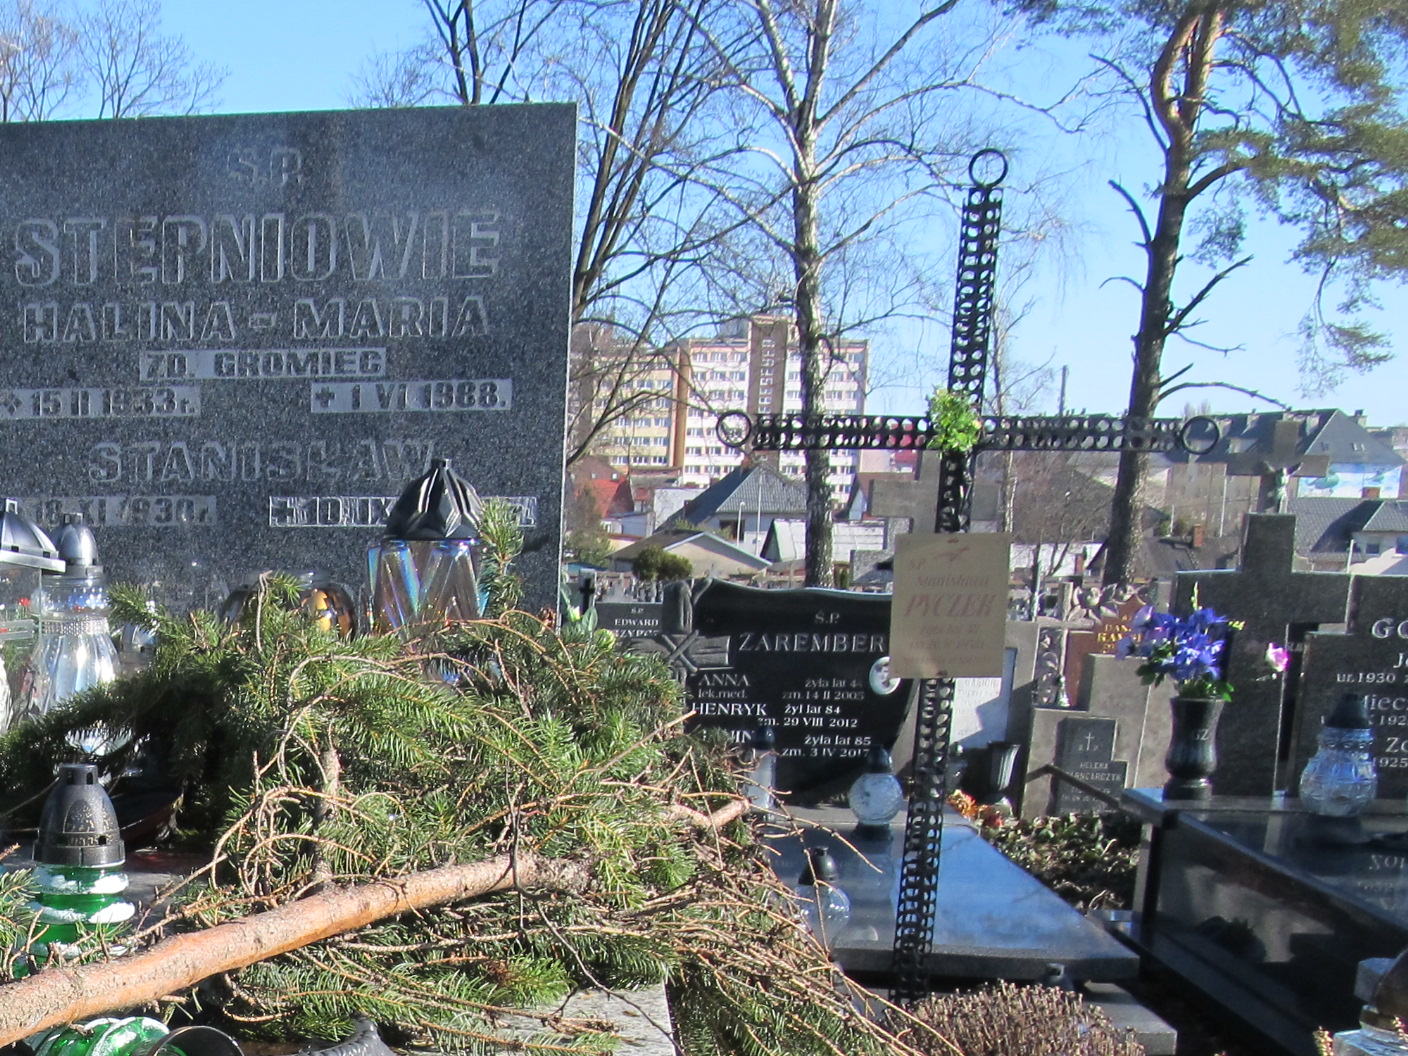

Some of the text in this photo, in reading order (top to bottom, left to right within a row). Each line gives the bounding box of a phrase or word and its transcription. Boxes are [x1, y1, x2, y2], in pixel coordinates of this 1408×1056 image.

[614, 618, 659, 626] EDWARD
[698, 673, 750, 687] ANNA
[832, 677, 846, 688] lat
[691, 702, 767, 716] HENRYK
[806, 704, 822, 714] lat
[825, 705, 841, 714] 84
[783, 717, 800, 726] 29
[803, 717, 823, 727] VIII
[829, 718, 858, 728] 2012
[835, 735, 850, 745] lat
[854, 736, 872, 746] 85
[839, 748, 871, 758] 2017
